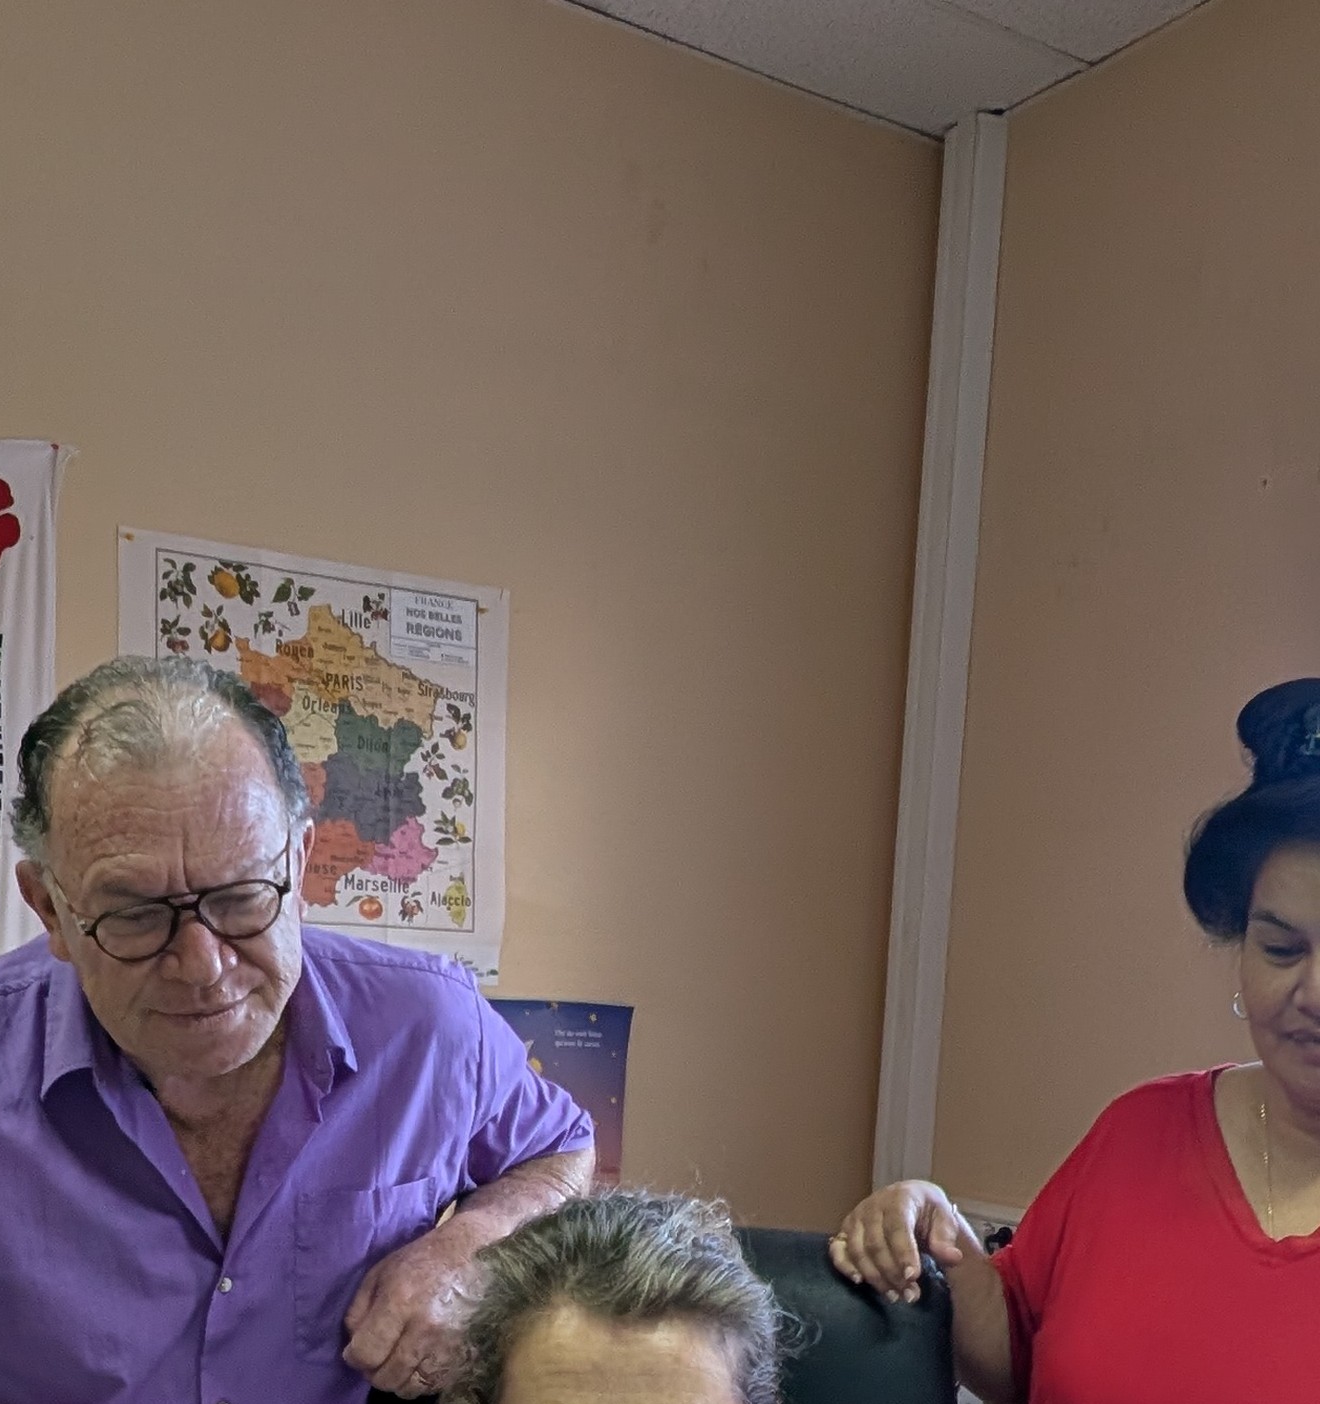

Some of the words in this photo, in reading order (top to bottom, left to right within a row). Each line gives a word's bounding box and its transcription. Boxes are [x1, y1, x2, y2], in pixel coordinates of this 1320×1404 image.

[341, 609, 372, 630] Lille
[275, 638, 314, 661] Rouen
[326, 672, 364, 692] PARIS
[417, 681, 476, 707] Strasbourg
[344, 874, 410, 894] Marseille
[431, 891, 472, 909] Ajaccio
